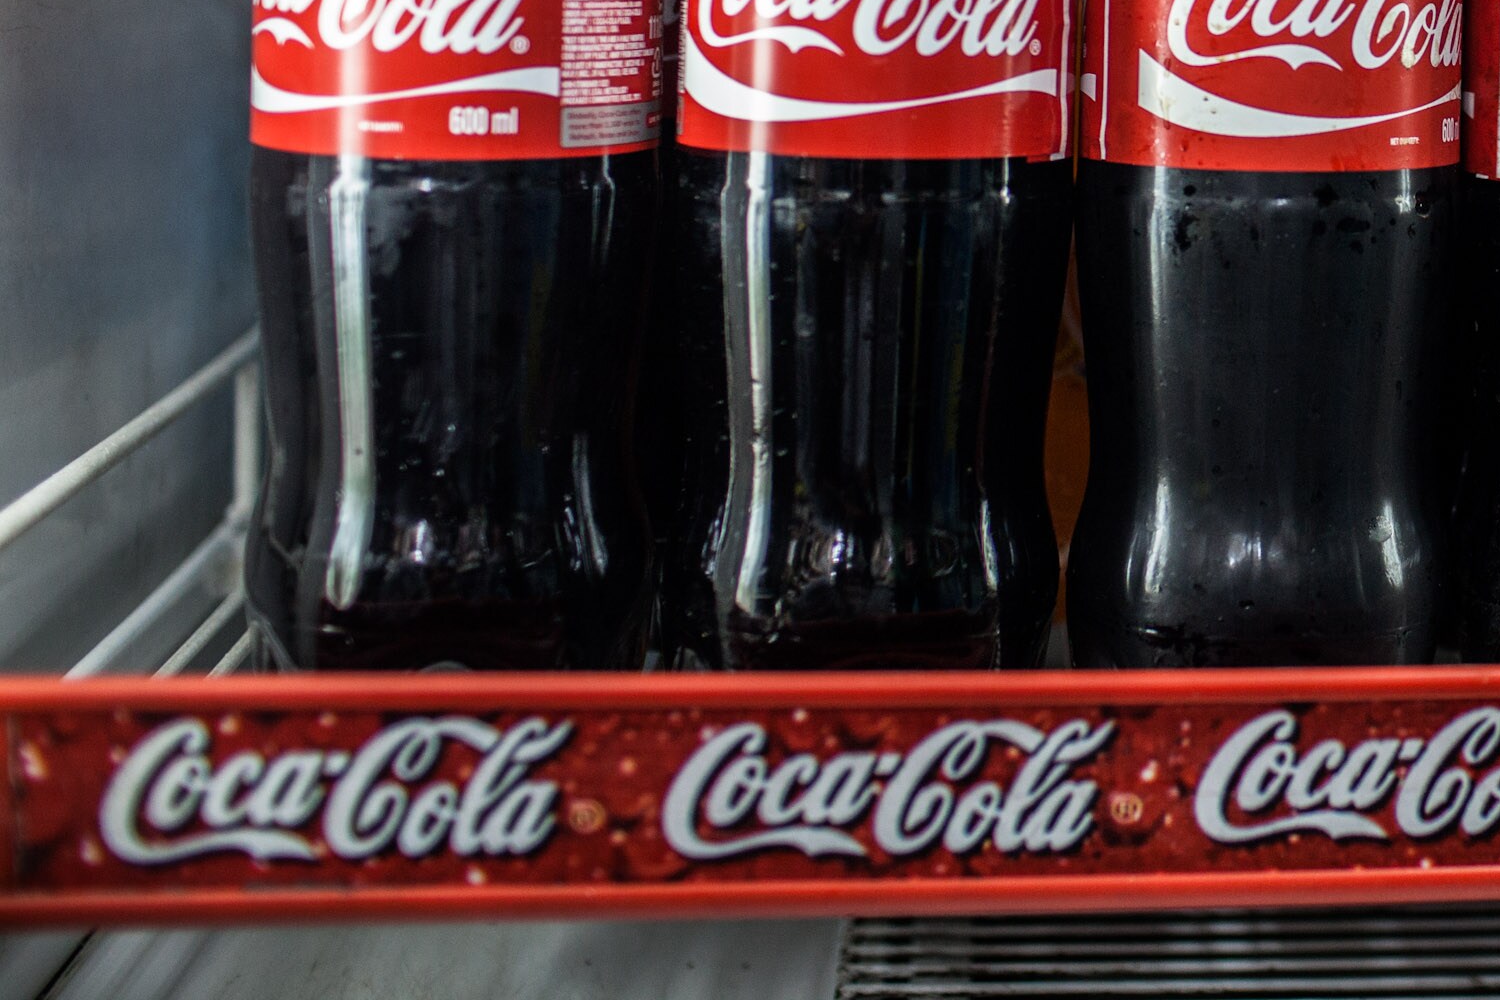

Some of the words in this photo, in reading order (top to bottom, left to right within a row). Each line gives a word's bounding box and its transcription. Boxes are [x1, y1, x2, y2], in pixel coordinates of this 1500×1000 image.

[449, 106, 489, 135] 600
[491, 106, 519, 135] ml
[1442, 117, 1455, 143] 600
[100, 716, 574, 865] Coca-Cola
[662, 719, 1116, 859] Coca-Cola
